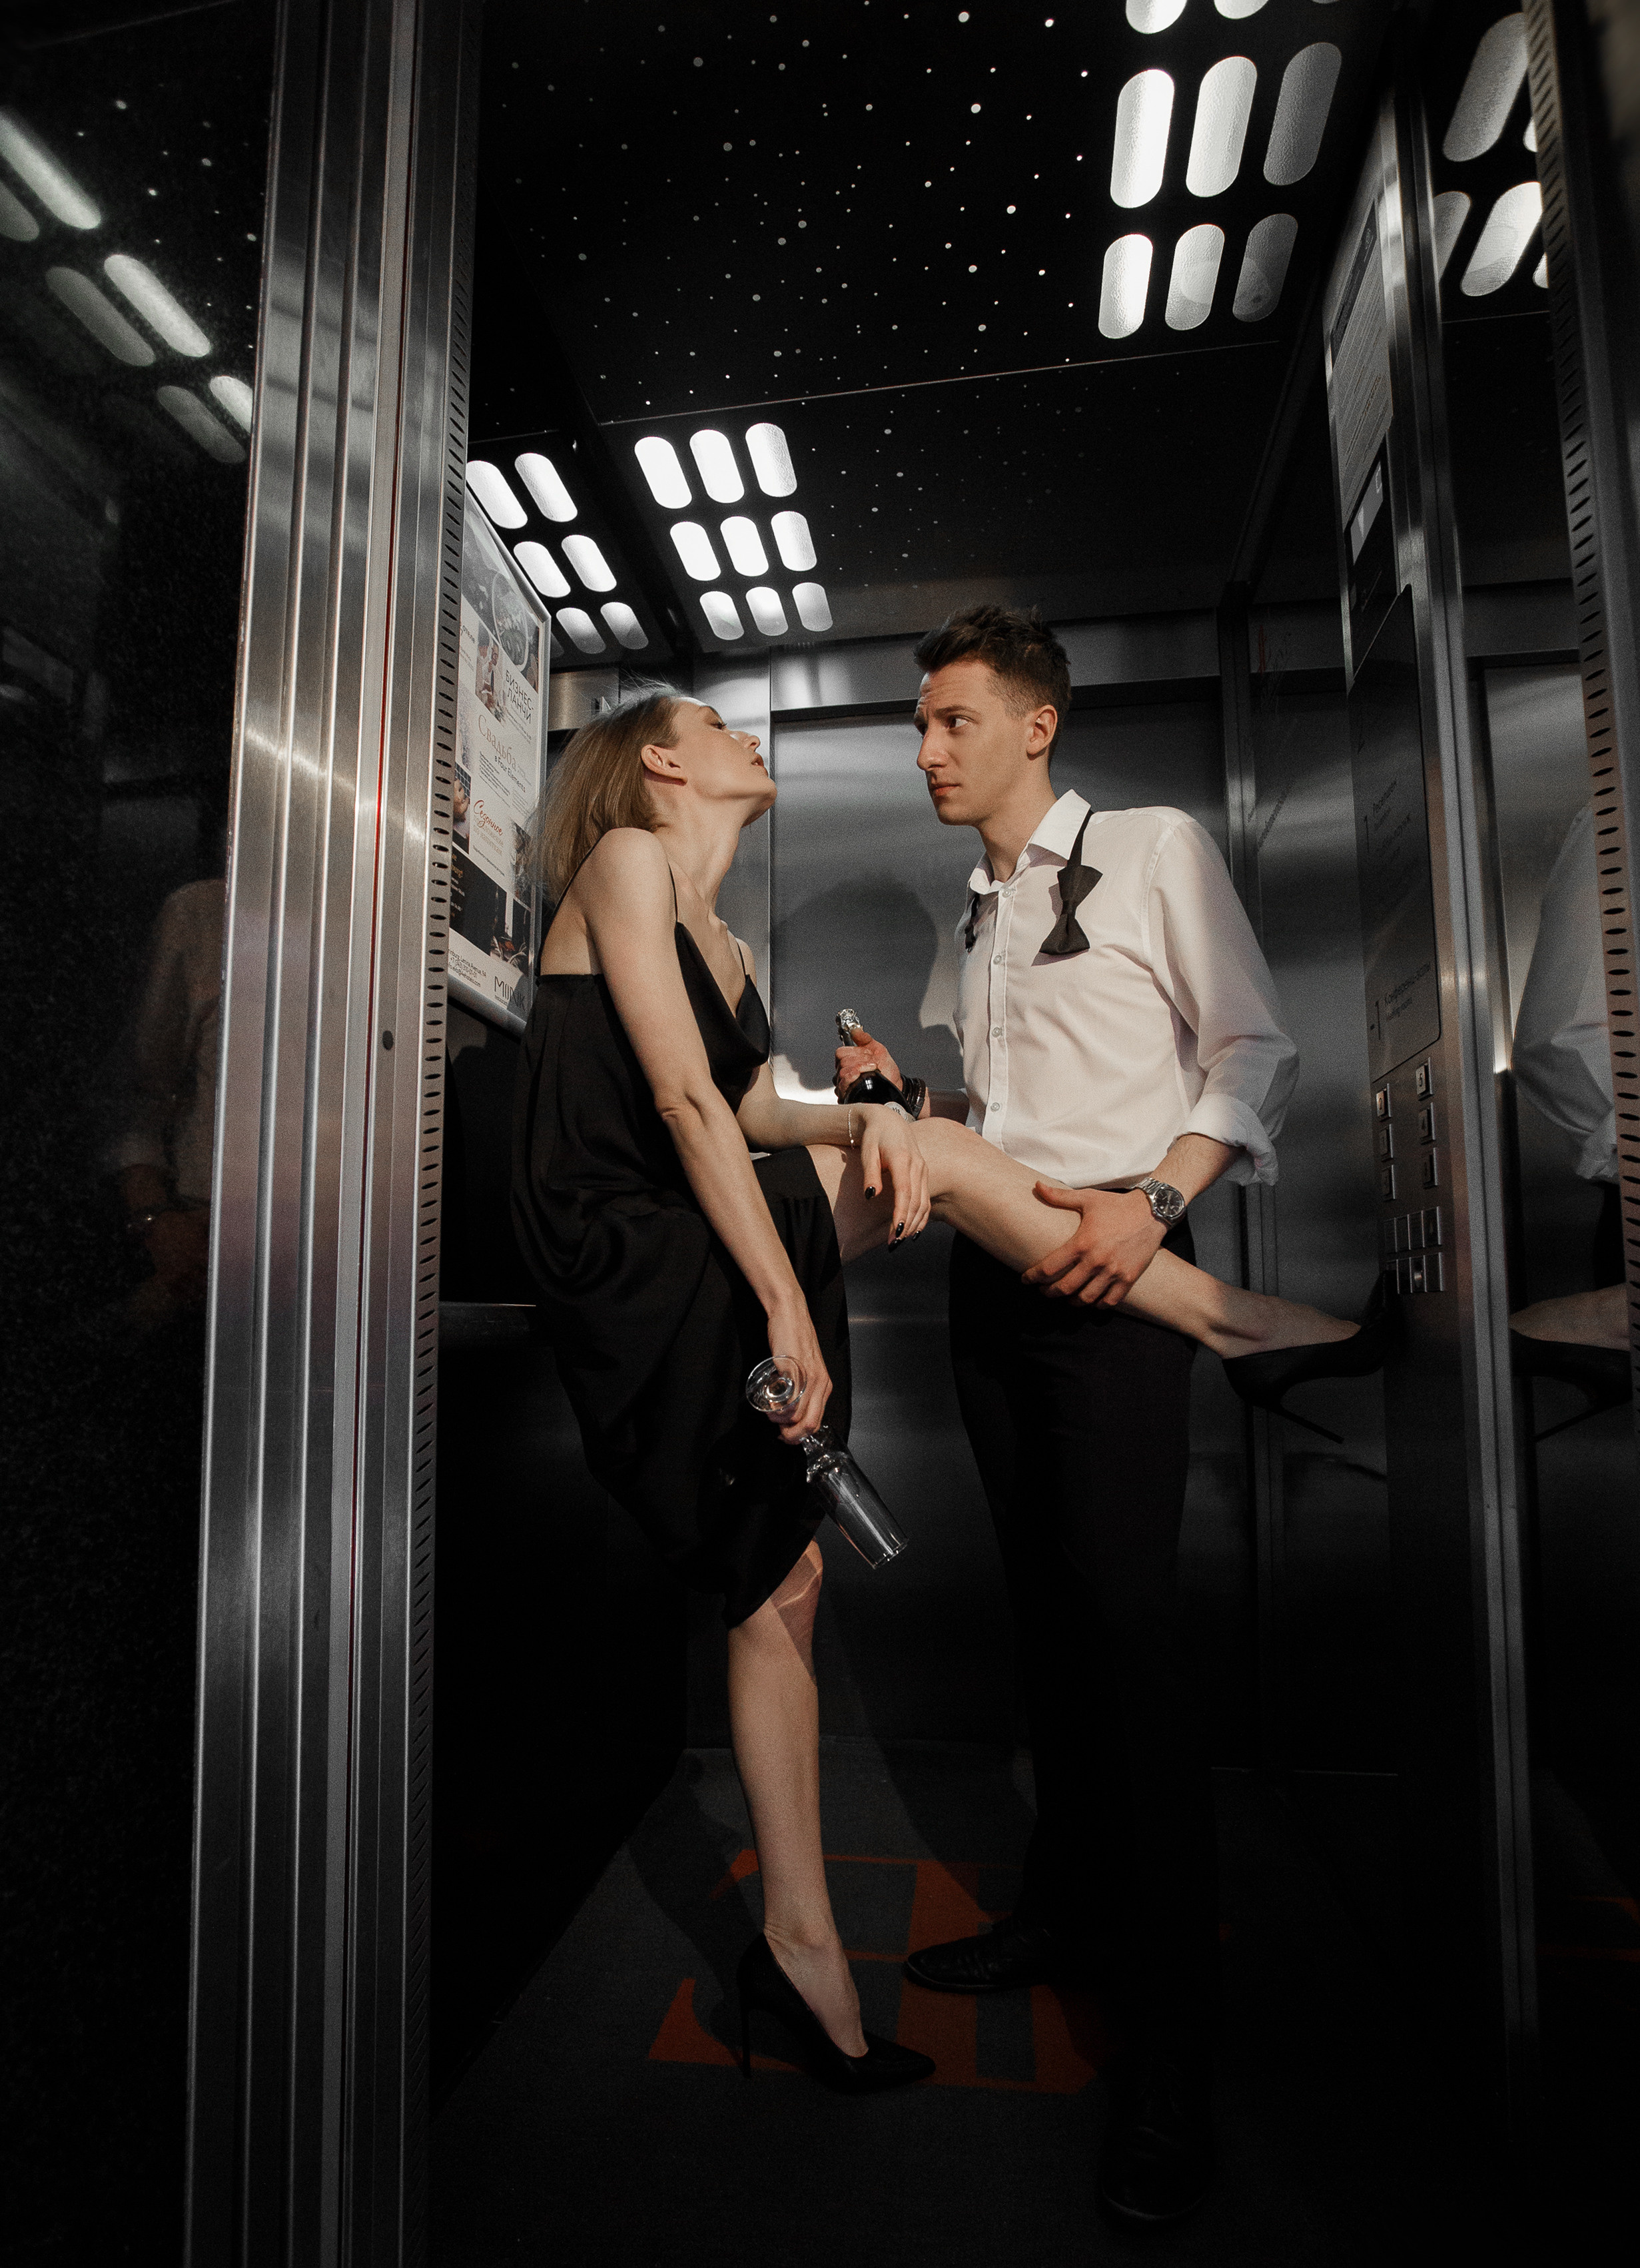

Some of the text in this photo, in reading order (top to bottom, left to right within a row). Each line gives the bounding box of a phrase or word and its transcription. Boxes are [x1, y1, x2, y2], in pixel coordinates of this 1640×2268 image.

[506, 669, 534, 711] БИЗНЕС-
[507, 687, 532, 724] ЛАНЧИ
[478, 714, 516, 771] Свадьба
[1419, 1072, 1424, 1088] 5
